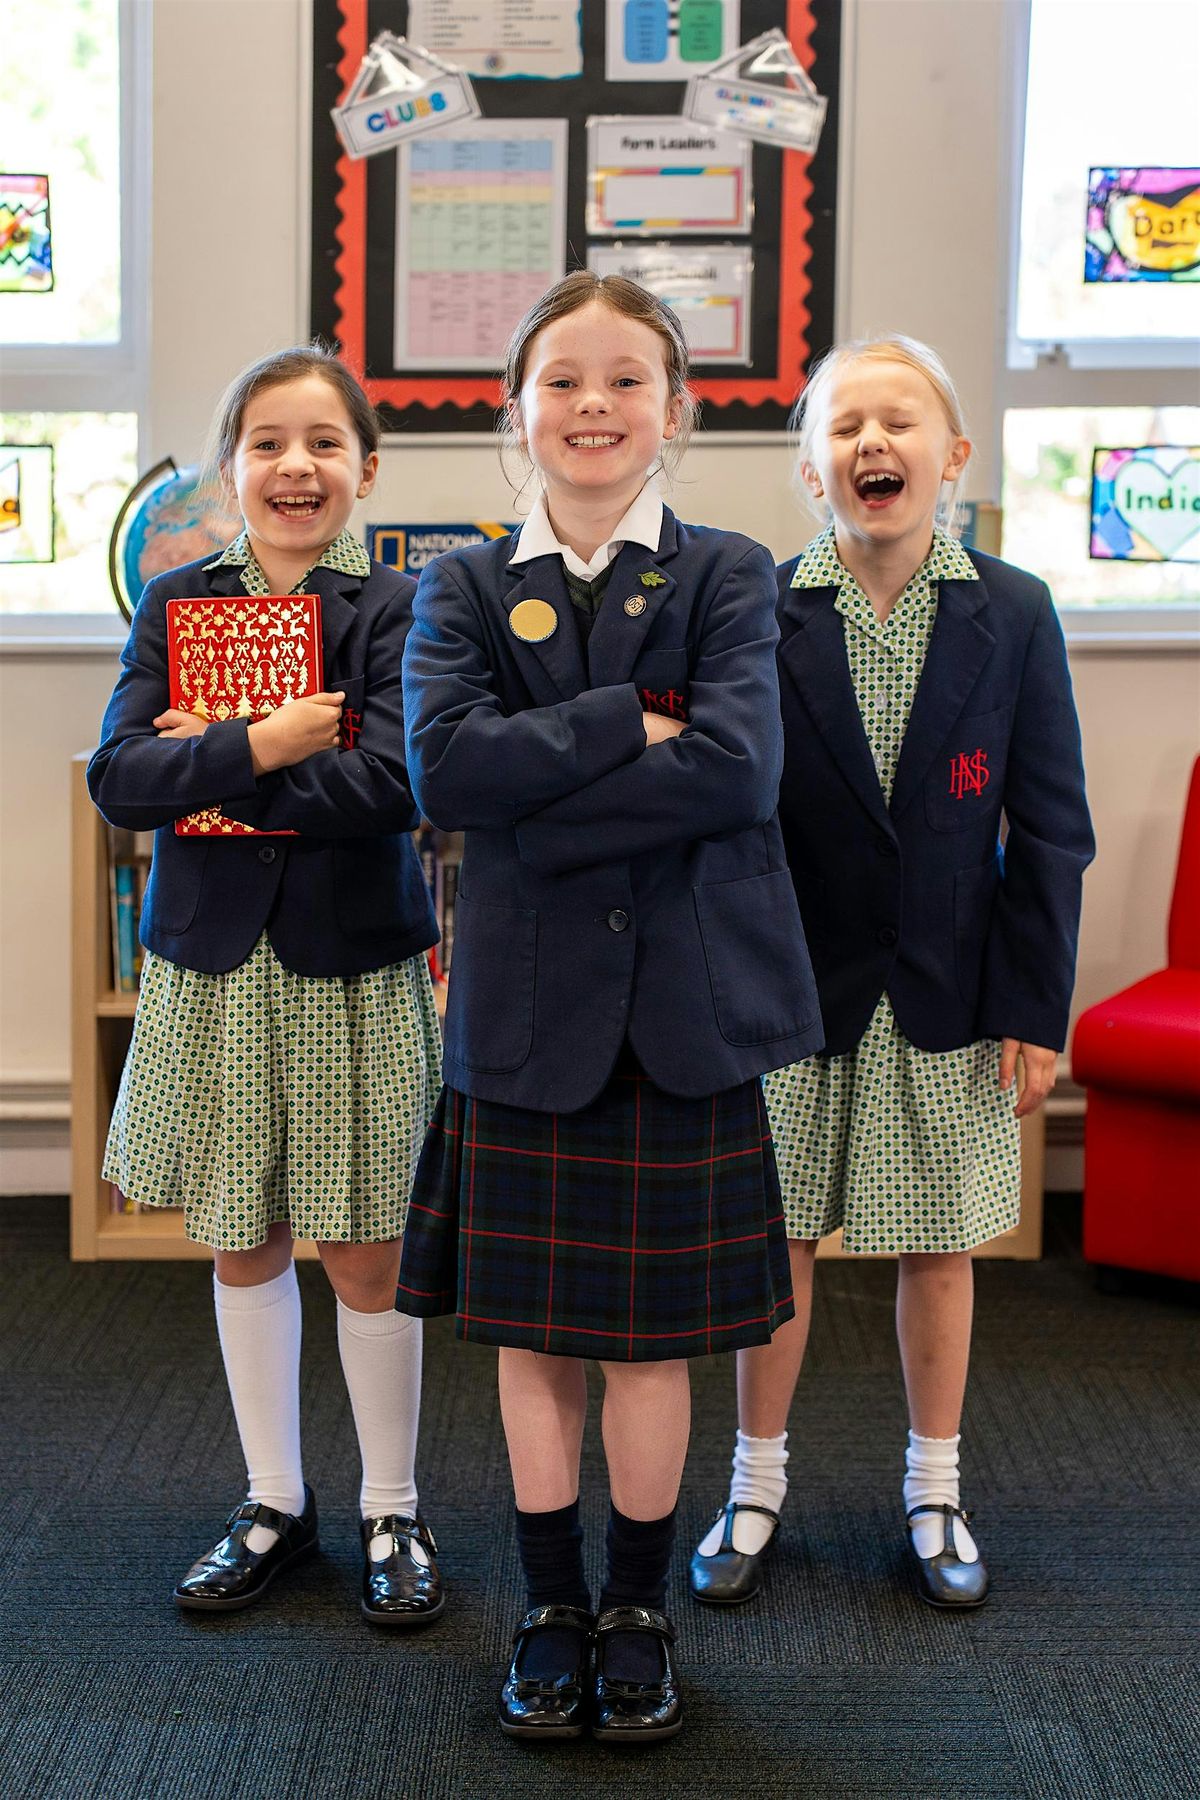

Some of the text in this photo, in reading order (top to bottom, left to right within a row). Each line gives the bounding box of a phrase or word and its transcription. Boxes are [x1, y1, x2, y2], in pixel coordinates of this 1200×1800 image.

[366, 91, 447, 133] CLUBS
[621, 135, 717, 151] Form Leaders
